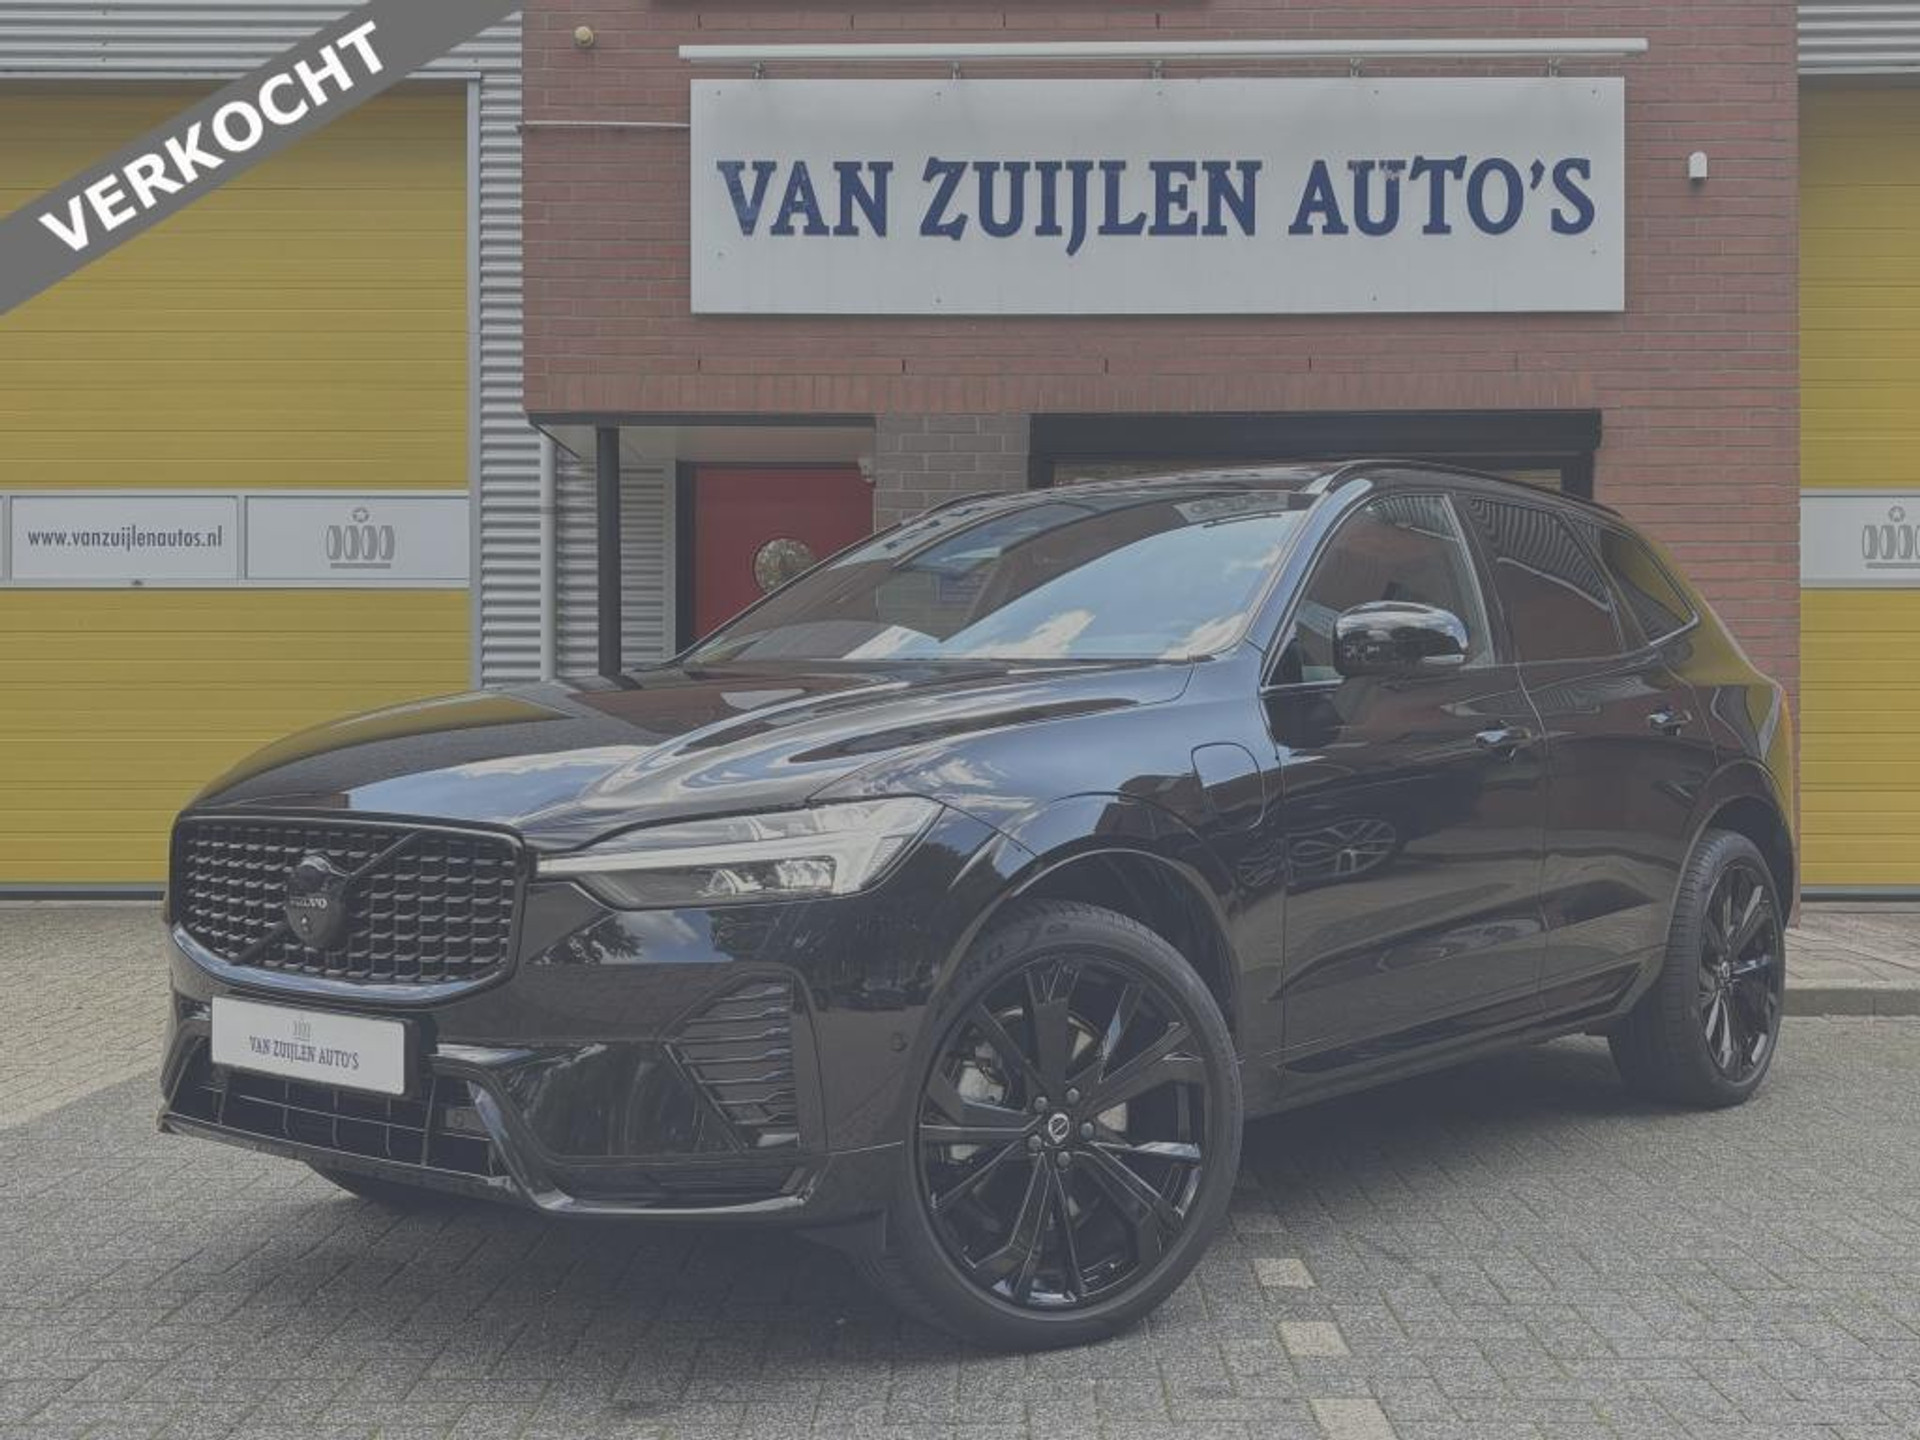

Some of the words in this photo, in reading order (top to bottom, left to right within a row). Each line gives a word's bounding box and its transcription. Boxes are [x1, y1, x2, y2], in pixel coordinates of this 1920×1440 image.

[716, 160, 893, 237] VAN
[919, 156, 1263, 257] ZUIJLEN
[1288, 155, 1597, 237] AUTO'S
[28, 524, 223, 552] www.vanzuijlenautos.nl
[250, 1035, 272, 1055] VAN
[273, 1040, 317, 1063] ZUIJLEN
[319, 1047, 360, 1070] AUTO'S
